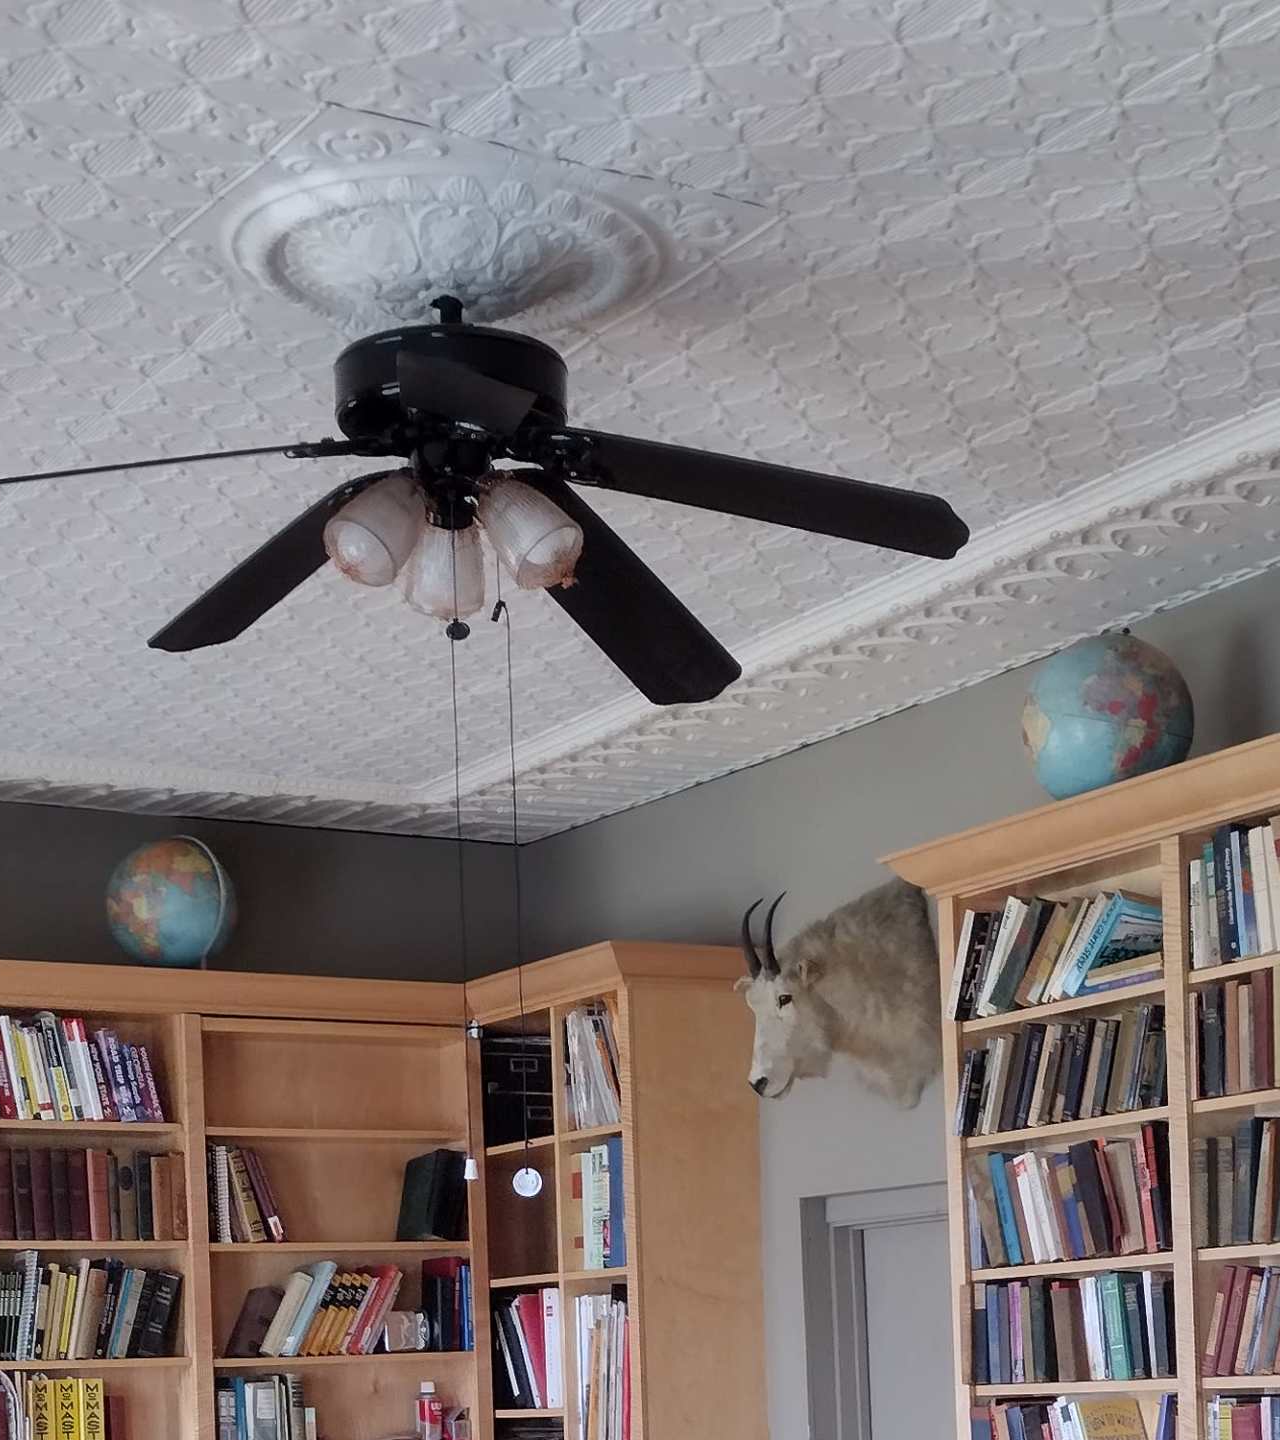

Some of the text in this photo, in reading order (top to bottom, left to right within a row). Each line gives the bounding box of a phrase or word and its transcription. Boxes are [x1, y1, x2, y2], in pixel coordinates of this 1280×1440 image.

[106, 1036, 119, 1061] ROAD
[113, 1063, 125, 1084] TRIP
[123, 1060, 141, 1104] Deep South
